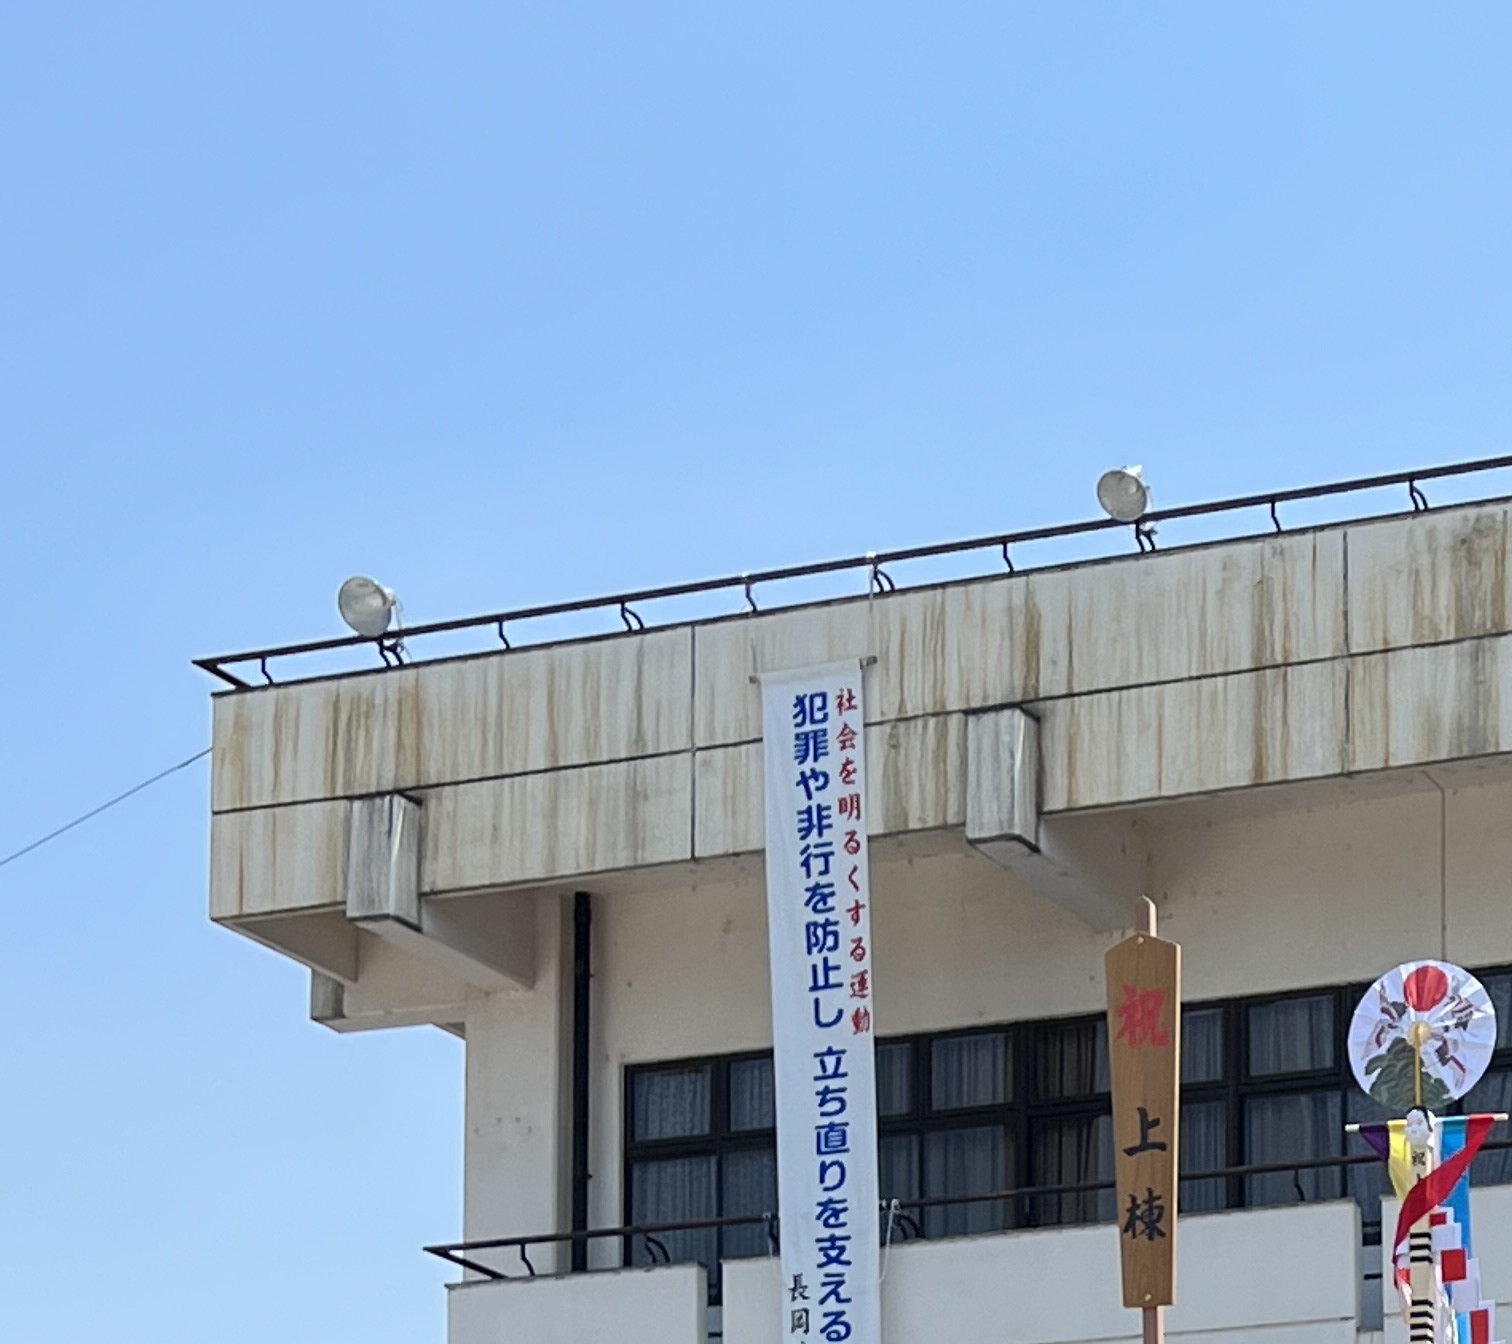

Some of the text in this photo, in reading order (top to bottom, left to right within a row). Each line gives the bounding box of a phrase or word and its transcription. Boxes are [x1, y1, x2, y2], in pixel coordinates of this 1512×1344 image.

[792, 690, 844, 1029] 犯罪や非行を防止し
[834, 687, 871, 1035] 社会を明るくする運動
[1115, 983, 1169, 1242] 祝 上棟
